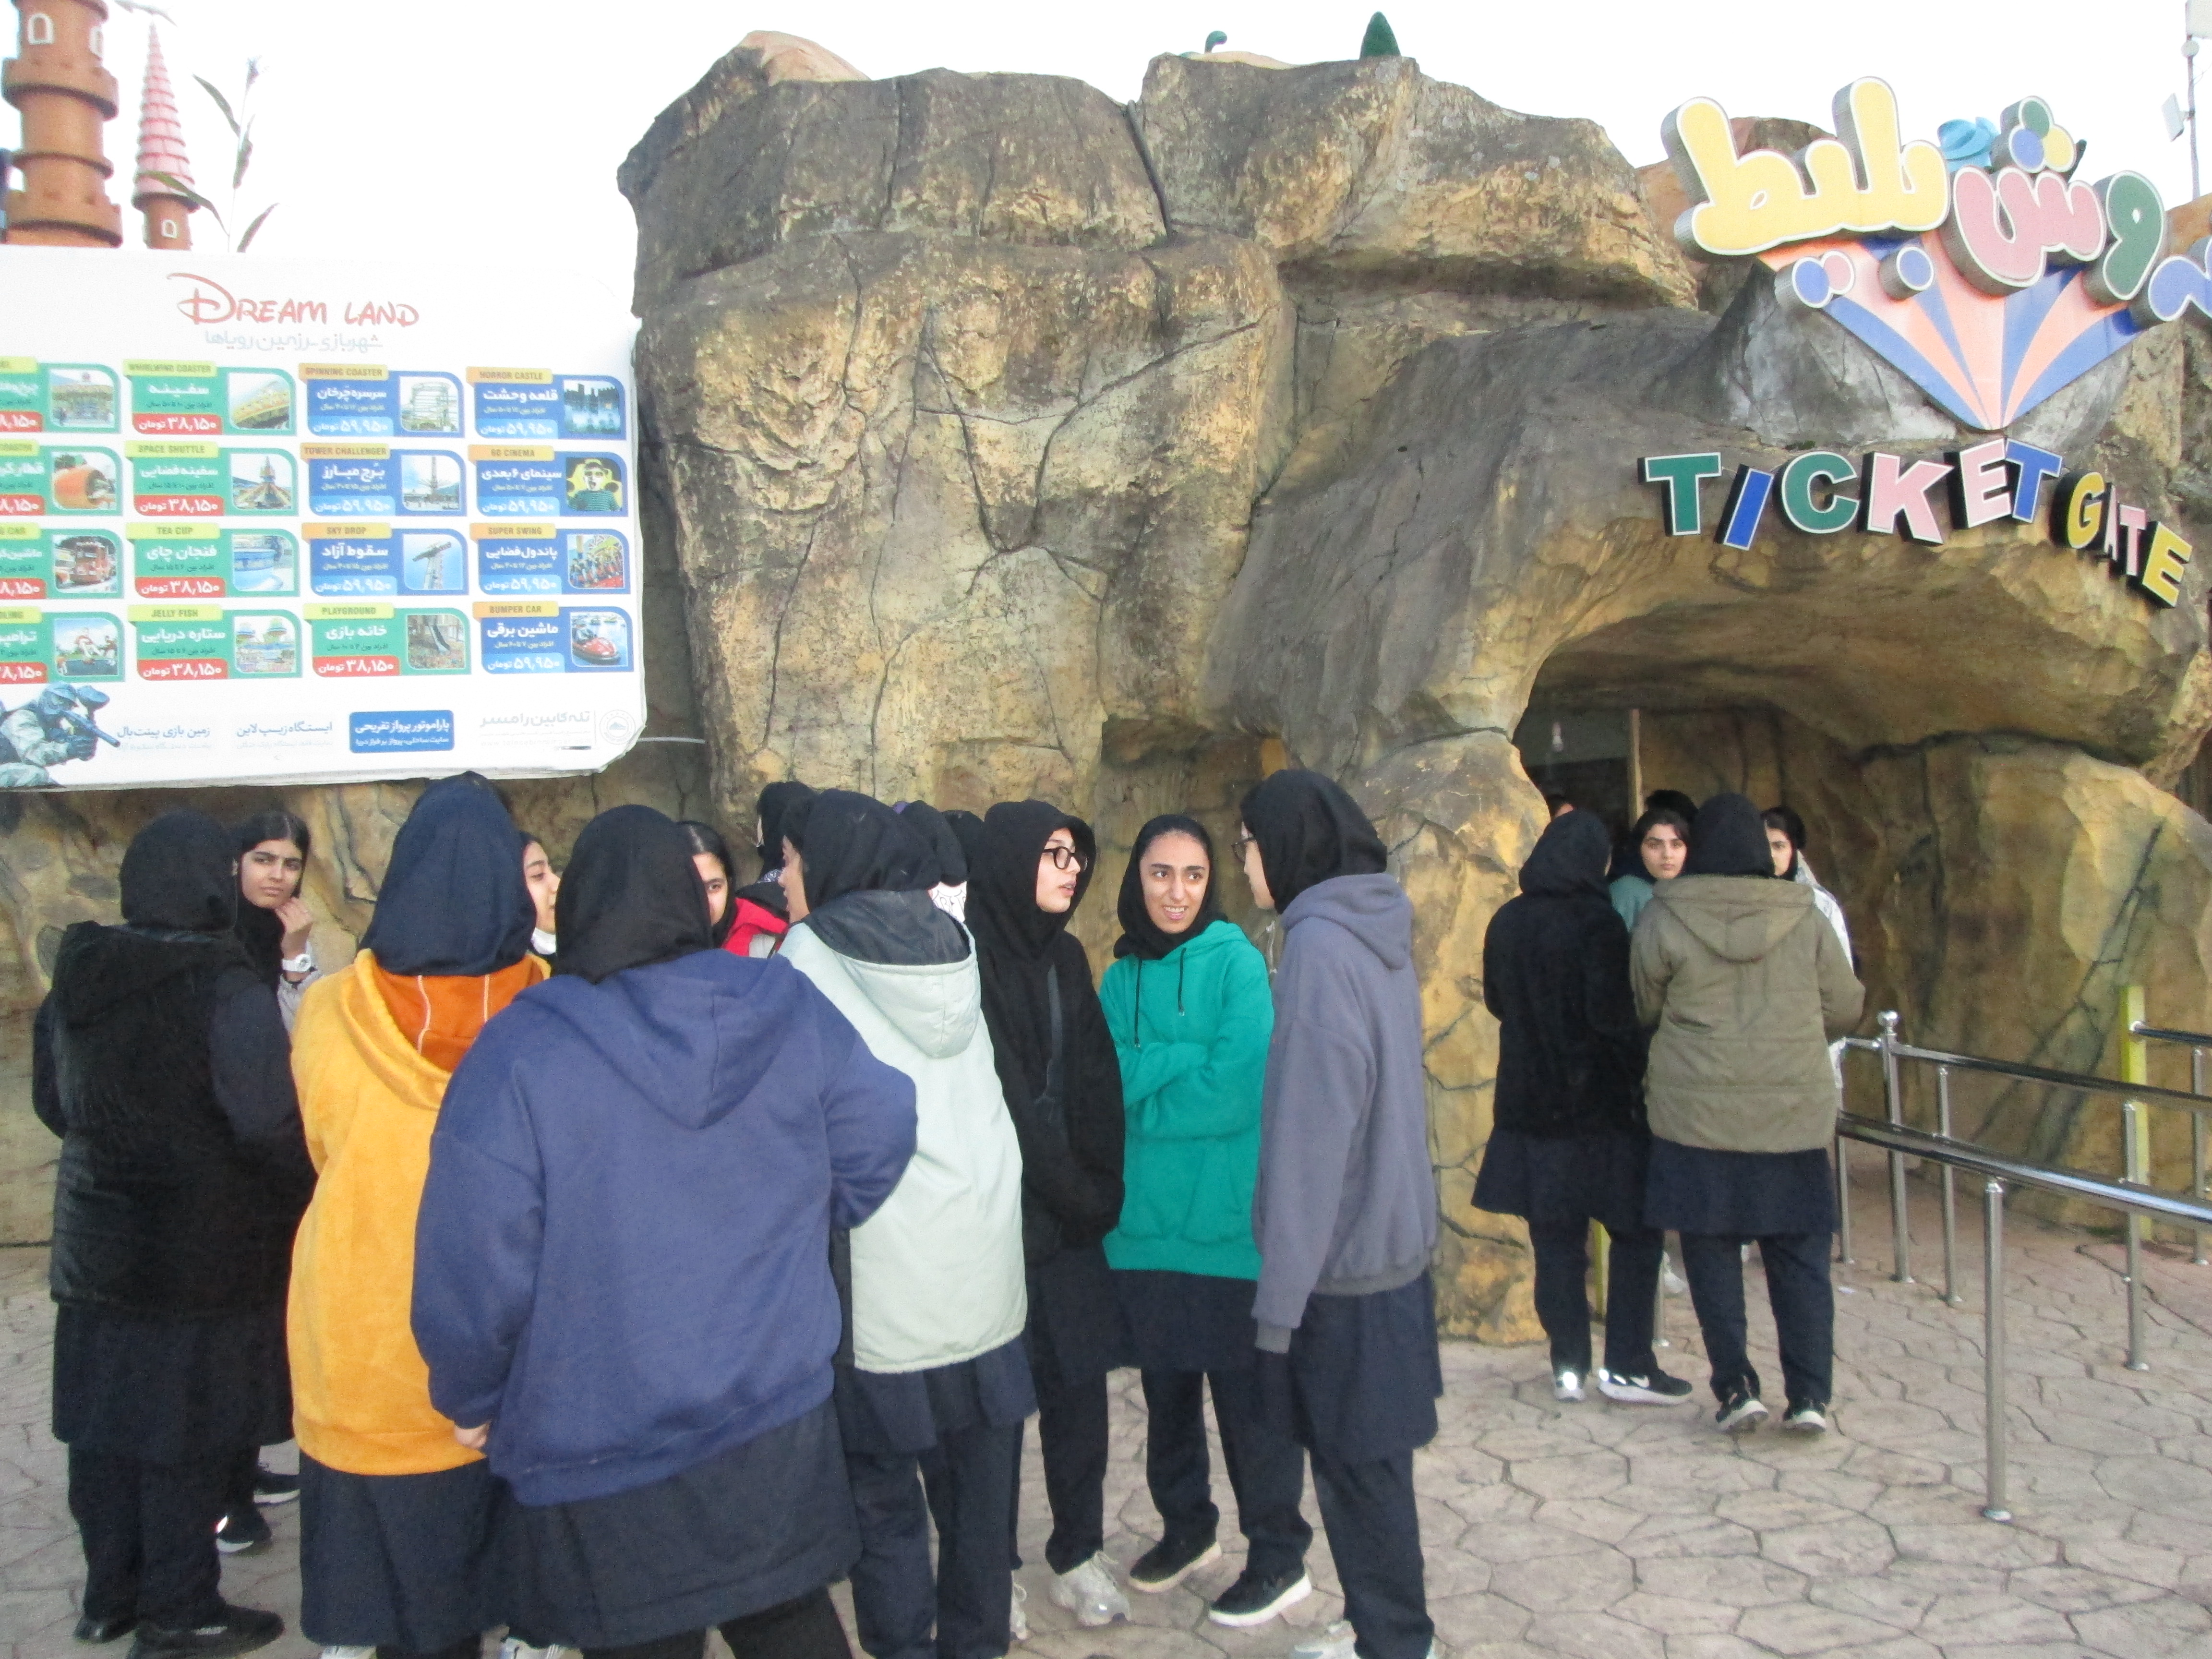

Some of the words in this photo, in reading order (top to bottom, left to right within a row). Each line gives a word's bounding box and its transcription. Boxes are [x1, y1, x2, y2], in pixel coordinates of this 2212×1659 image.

[1661, 76, 1951, 308] بلیط
[1952, 95, 2212, 323] روش
[347, 368, 382, 376] COASTER
[515, 372, 543, 380] CASTLE
[1639, 438, 2063, 551] TICKET
[2053, 471, 2193, 608] GATE
[322, 542, 345, 559] آزاد
[347, 545, 388, 559] سقوط
[152, 609, 176, 617] JELLY
[359, 625, 387, 636] خانه
[488, 623, 515, 638] برقی
[518, 622, 559, 638] ماشین
[480, 713, 529, 728] رامسر
[531, 711, 568, 726] کابین
[569, 711, 590, 722] تله
[162, 725, 184, 738] بازی
[187, 727, 211, 738] زمین
[236, 723, 257, 737] لاین
[289, 721, 333, 732] ایستگاه
[355, 721, 389, 733] تفریحی
[389, 720, 411, 733] پرواز
